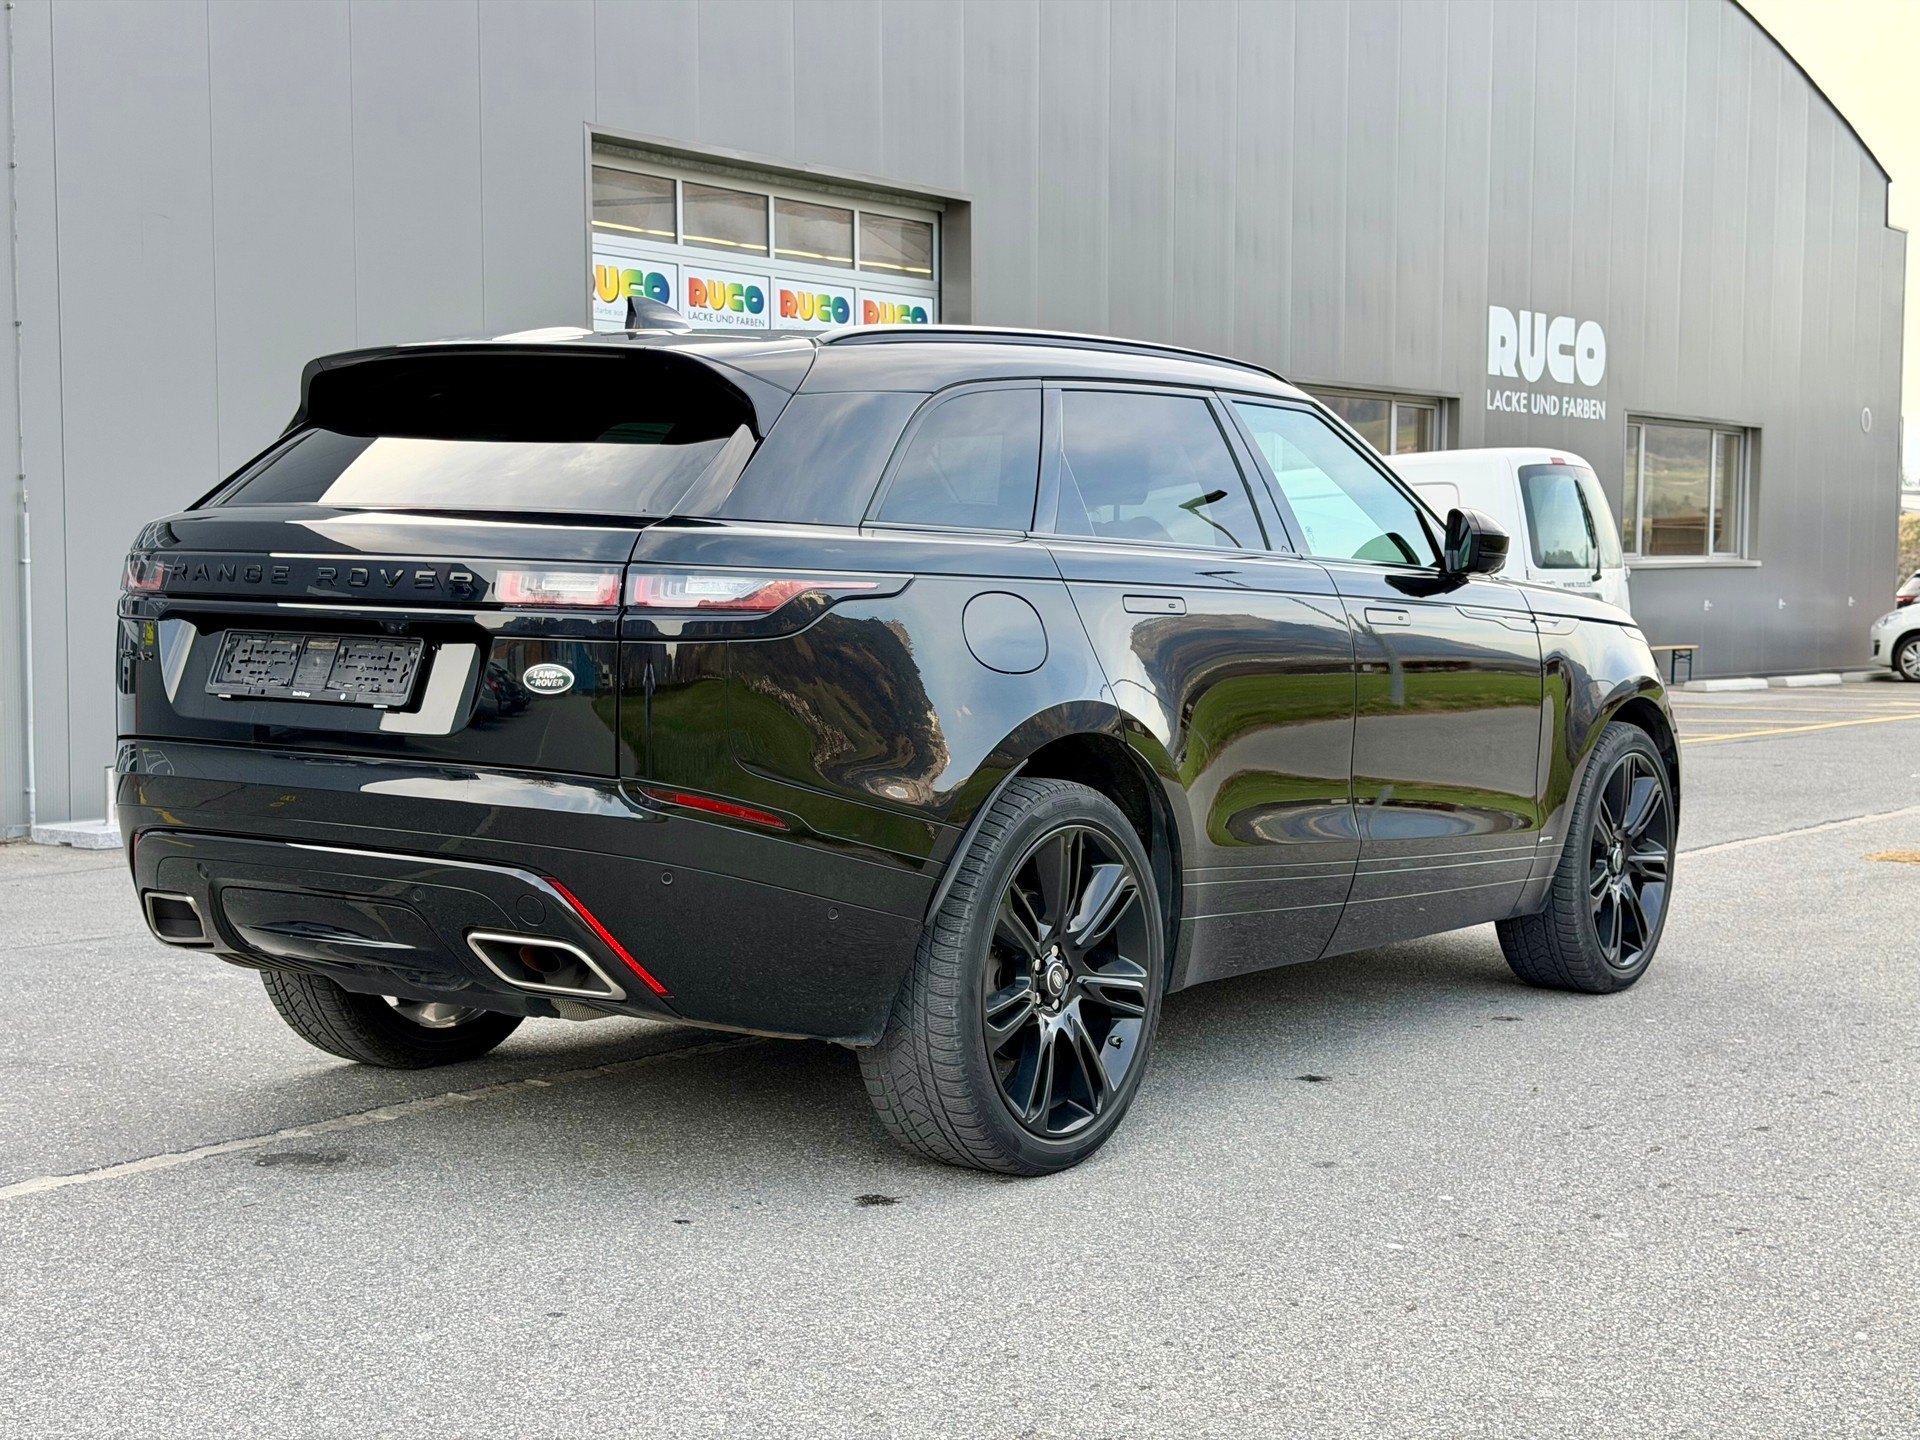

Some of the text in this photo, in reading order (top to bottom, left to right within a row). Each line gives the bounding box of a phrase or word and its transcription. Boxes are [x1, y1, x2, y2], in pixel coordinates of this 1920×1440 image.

[593, 264, 670, 304] UCO
[688, 276, 765, 315] RUCO
[688, 311, 714, 322] LACKE
[715, 315, 735, 325] UND
[735, 316, 766, 328] FARBEN
[779, 289, 850, 324] RUCO
[1487, 305, 1607, 387] RUCO
[1486, 388, 1607, 420] LACKE UND FARBEN
[172, 562, 474, 594] RANGE ROVER
[533, 670, 557, 678] LAND
[535, 679, 563, 687] ROVER
